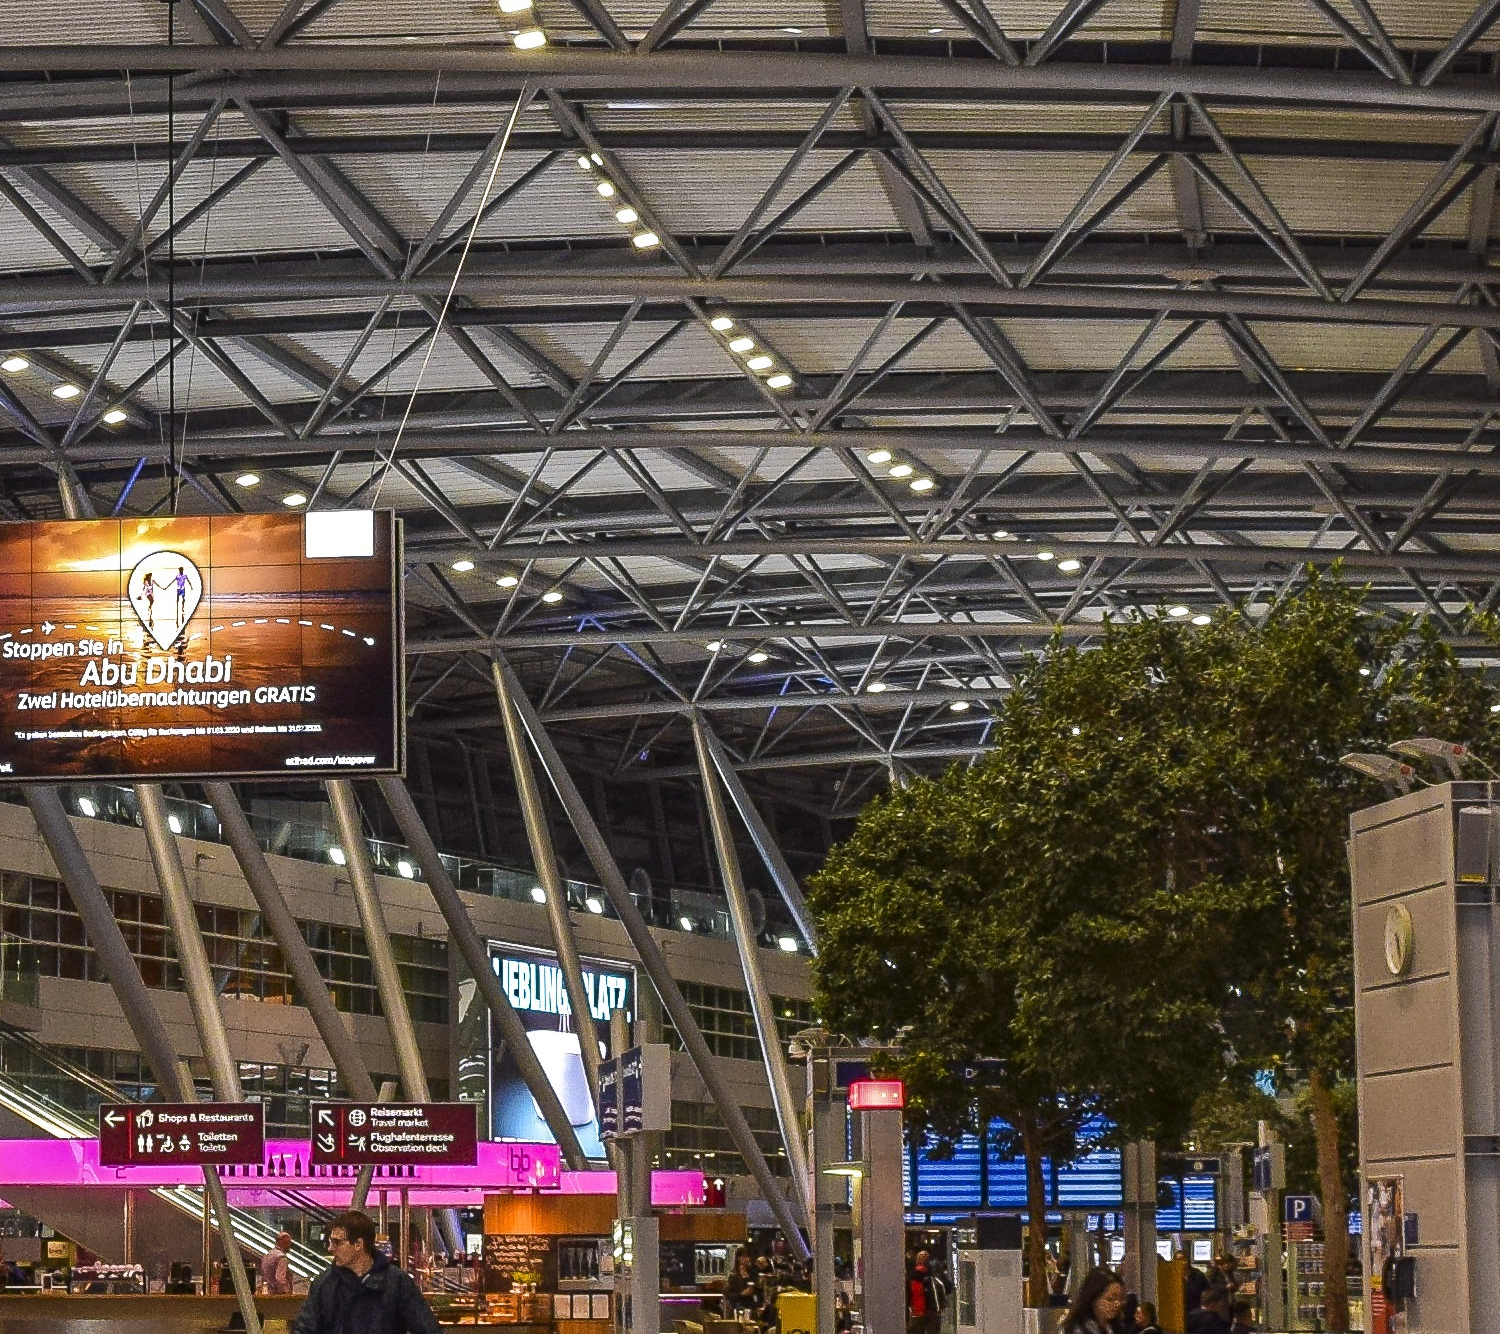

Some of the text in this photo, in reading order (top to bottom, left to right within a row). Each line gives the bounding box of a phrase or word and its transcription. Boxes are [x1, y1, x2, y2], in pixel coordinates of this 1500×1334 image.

[3, 638, 123, 661] Stoppen Sie in
[80, 655, 232, 686] Abu Dhabi
[18, 686, 316, 711] Zwei Hotelübernachtungen GRATIS
[371, 1108, 423, 1117] Reisemarkt
[159, 1113, 254, 1124] Shops & Restaurants
[371, 1118, 428, 1127] Travel market
[198, 1133, 238, 1141] Toiletten
[371, 1133, 454, 1143] Flughafenterrasse
[198, 1143, 227, 1152] Toilets
[371, 1143, 448, 1152] Observation deck
[1294, 1200, 1305, 1219] P
